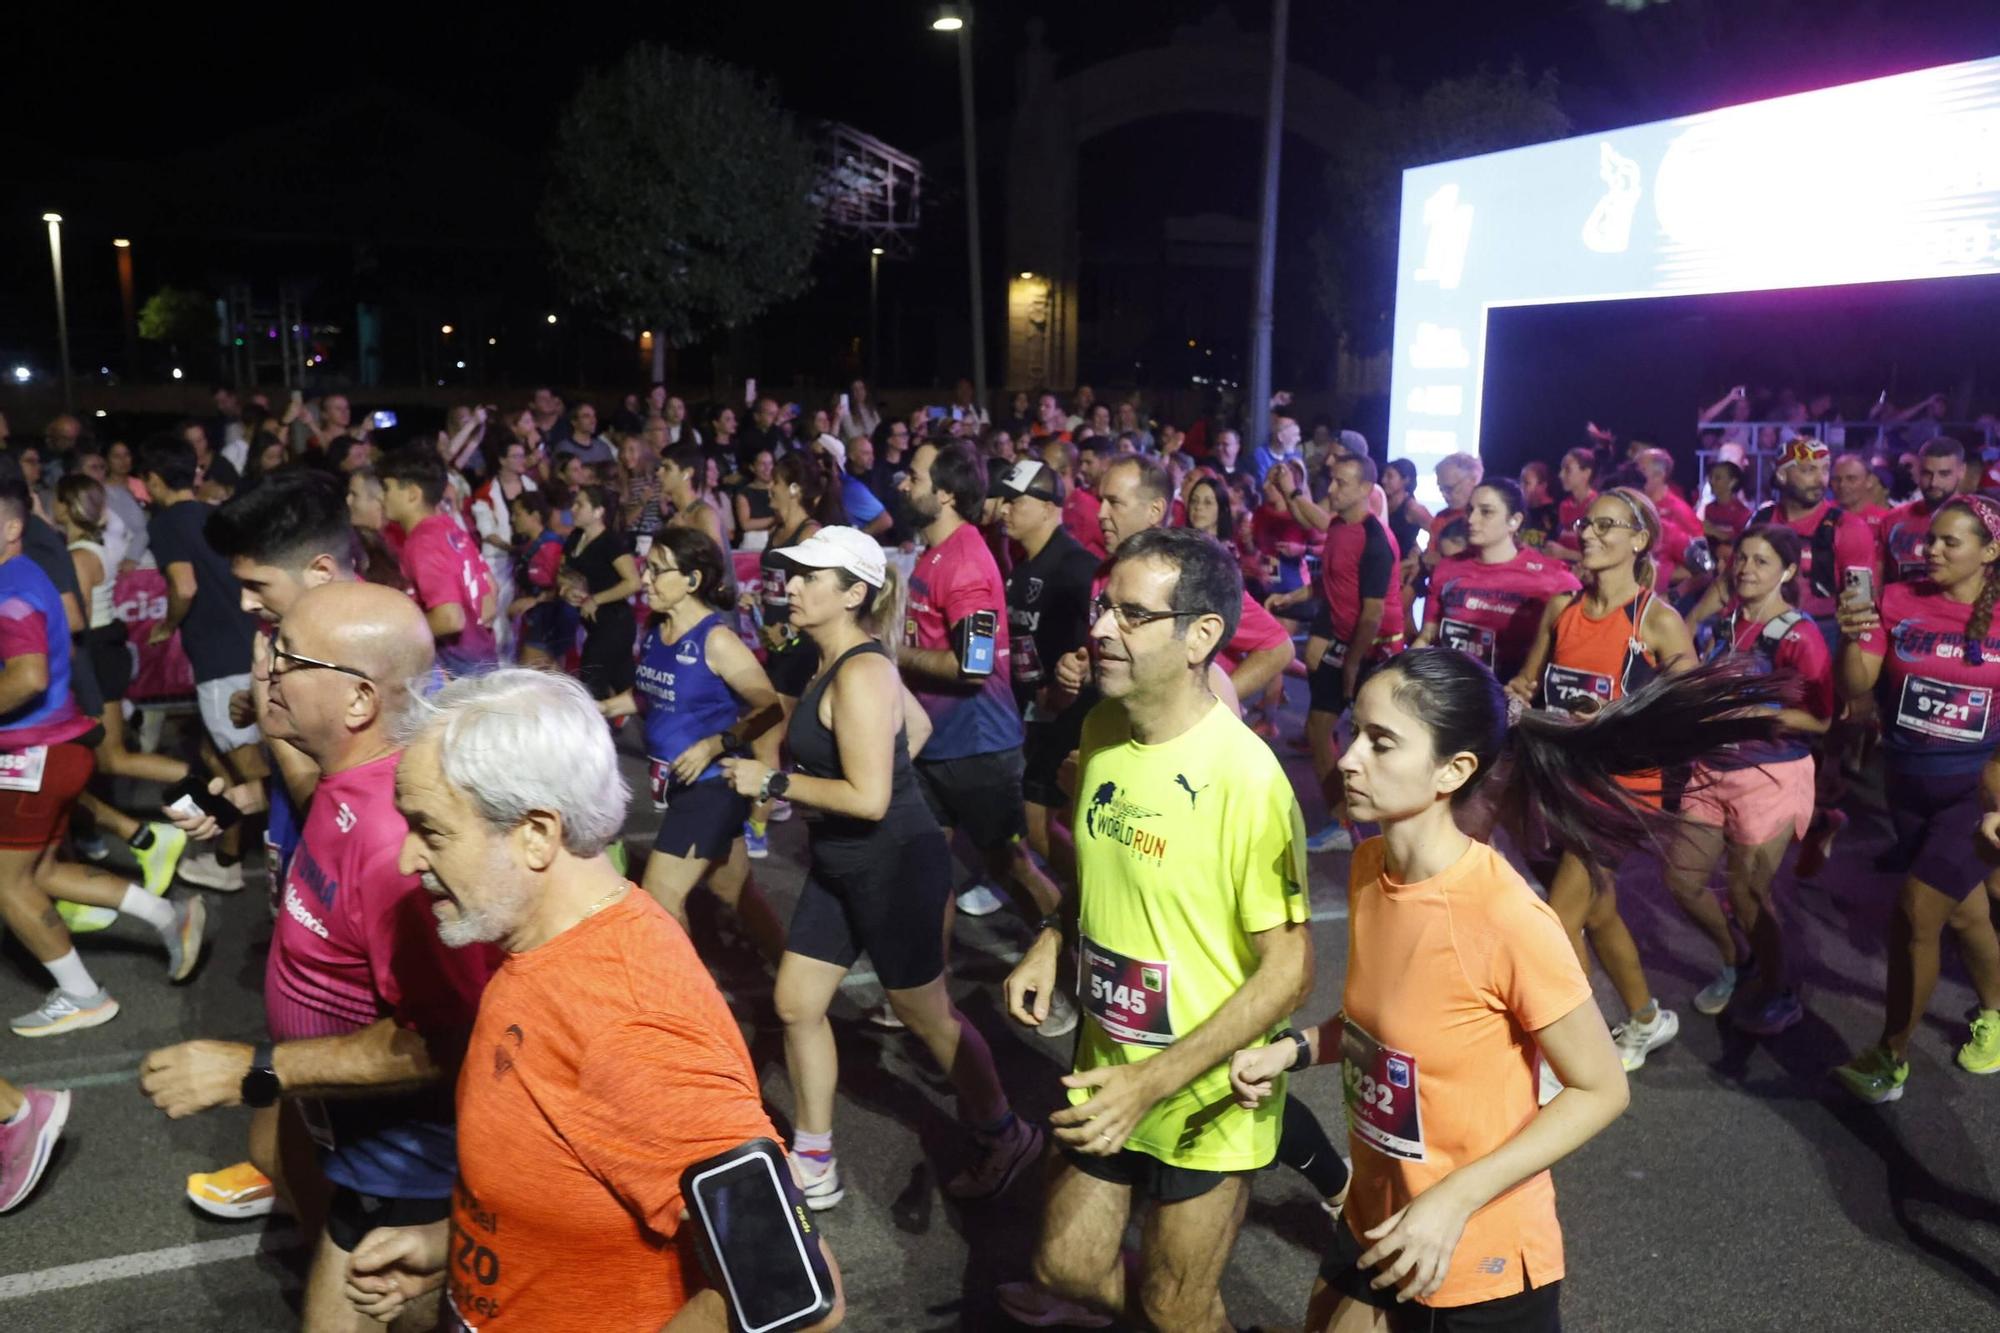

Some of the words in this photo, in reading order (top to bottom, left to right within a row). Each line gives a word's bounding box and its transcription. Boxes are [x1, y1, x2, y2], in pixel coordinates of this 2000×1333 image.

[1918, 695, 1970, 722] 9721
[1097, 813, 1134, 847] WORLD
[1133, 829, 1167, 859] RUN
[1091, 973, 1147, 1015] 5145
